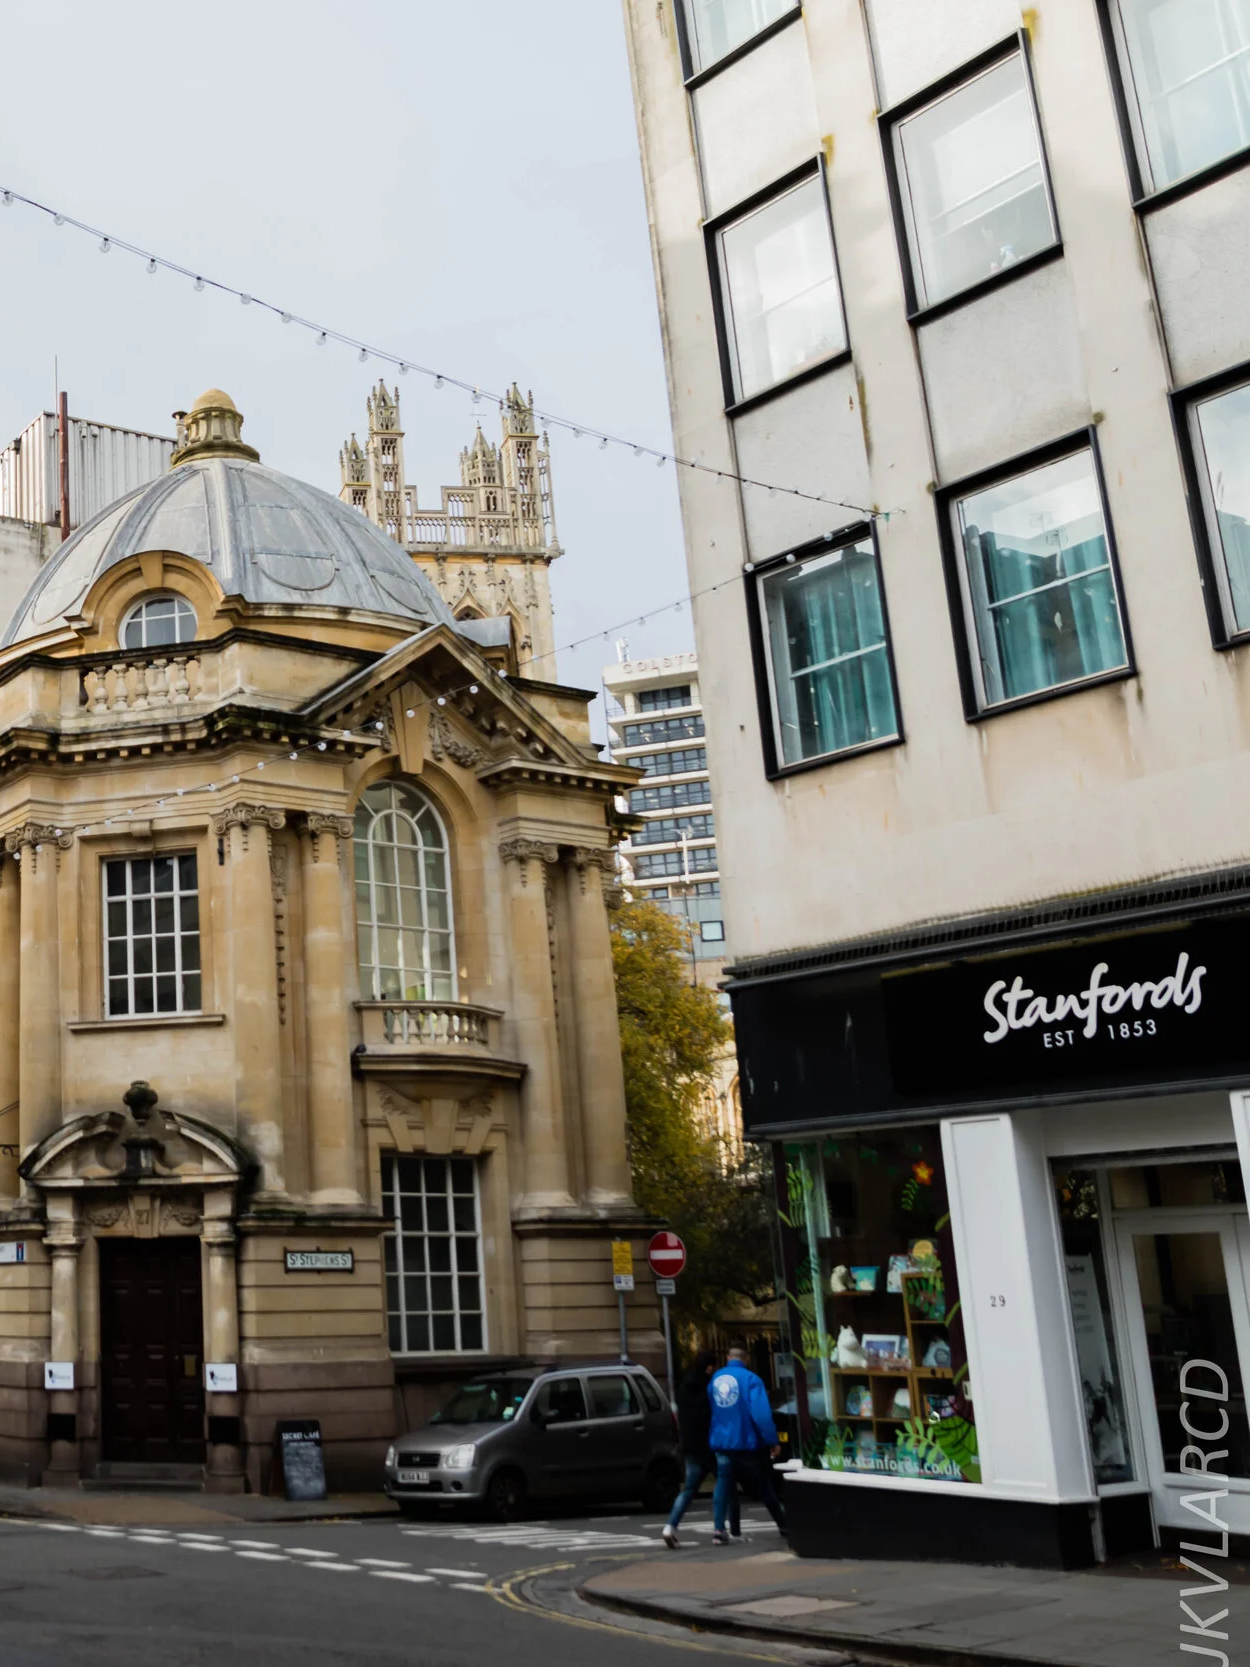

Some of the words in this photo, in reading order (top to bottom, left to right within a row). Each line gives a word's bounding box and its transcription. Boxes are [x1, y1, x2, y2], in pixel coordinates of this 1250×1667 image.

[983, 951, 1207, 1043] Stanfords
[1043, 1030, 1075, 1049] EST
[1107, 1019, 1157, 1040] 1853
